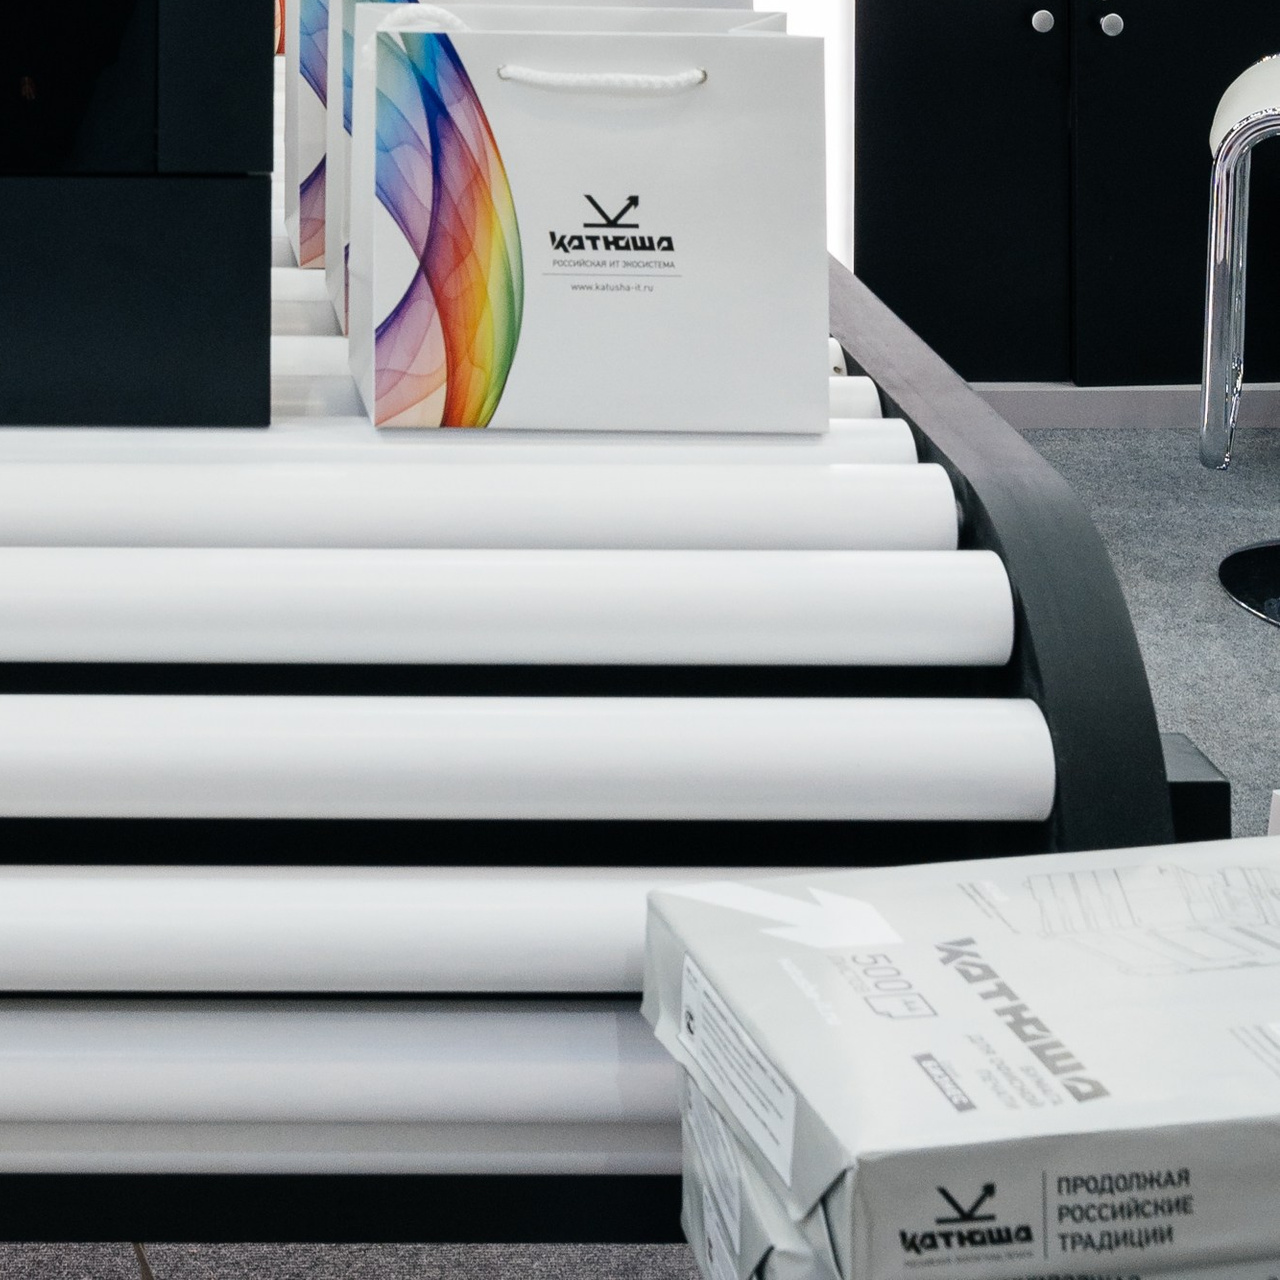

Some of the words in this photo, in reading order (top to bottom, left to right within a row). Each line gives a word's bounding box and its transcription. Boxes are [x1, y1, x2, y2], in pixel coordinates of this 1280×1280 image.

[552, 258, 607, 268] РОССИЙСКАЯ
[609, 260, 620, 268] ИТ
[622, 260, 676, 269] ЭКОСИСТЕМА
[570, 282, 654, 292] www.katusha-it.ru
[851, 953, 914, 992] 500
[1057, 1167, 1191, 1196] ПРОДОЛЖАЯ
[1057, 1194, 1195, 1224] РОССИЙСКИЕ
[1058, 1224, 1174, 1255] ТРАДИЦИИ
